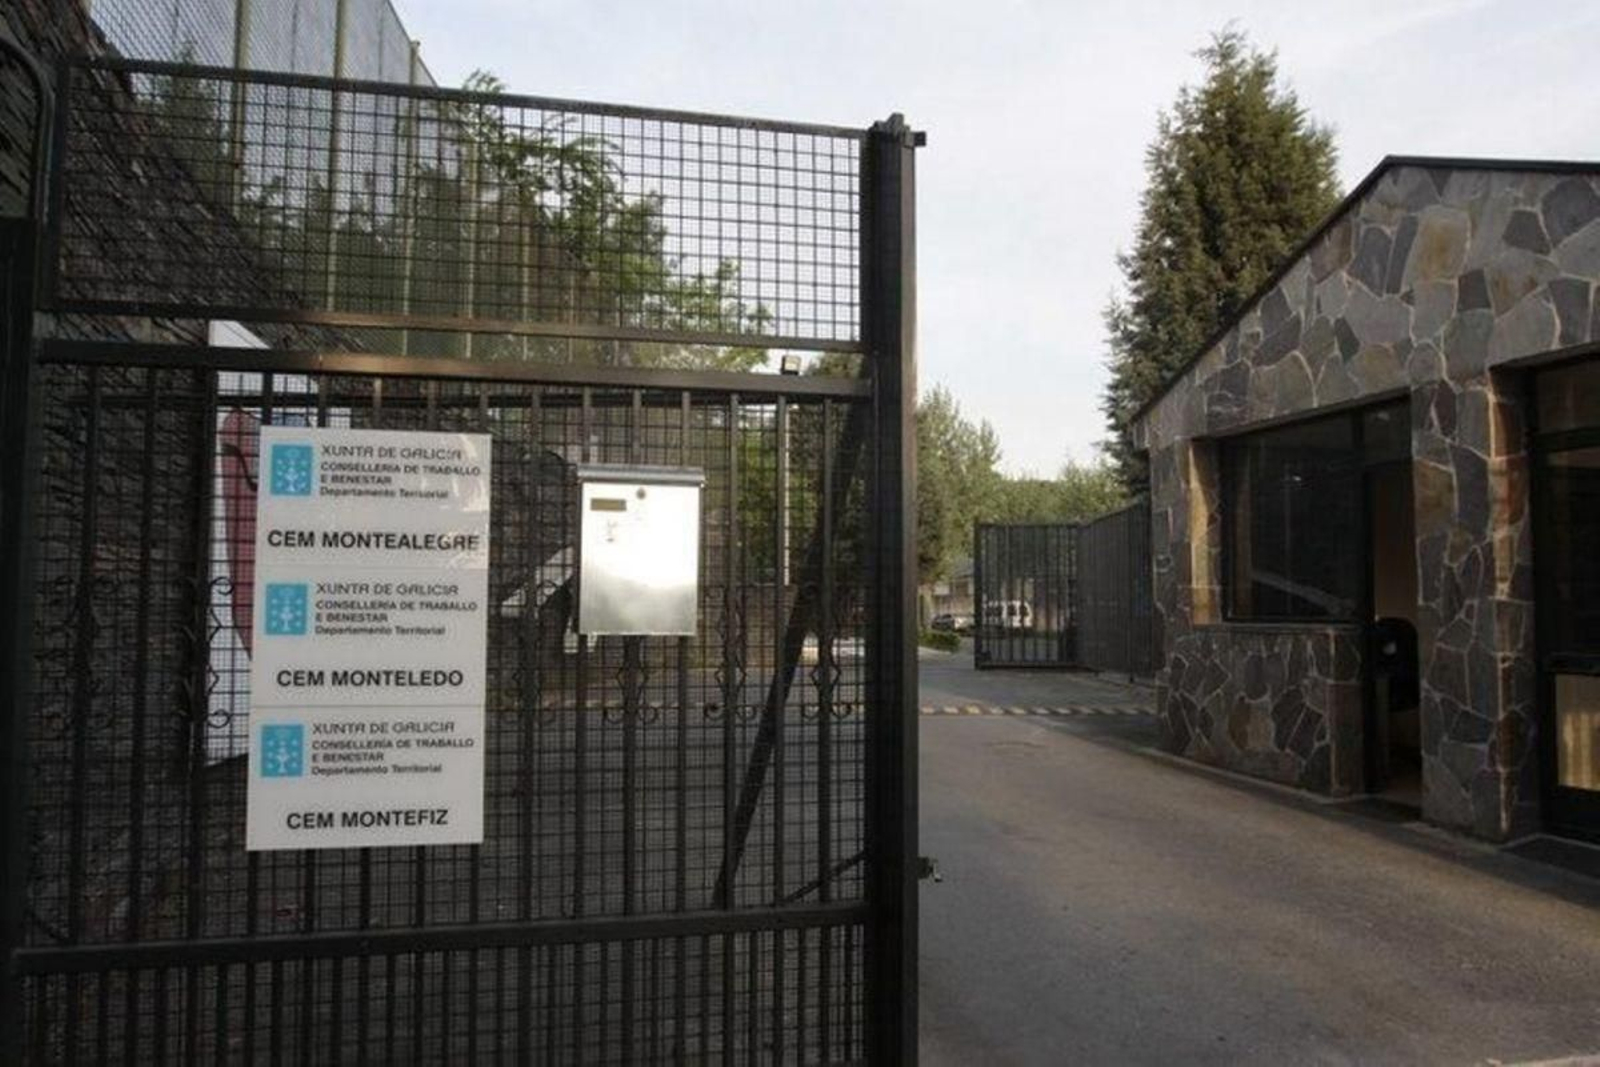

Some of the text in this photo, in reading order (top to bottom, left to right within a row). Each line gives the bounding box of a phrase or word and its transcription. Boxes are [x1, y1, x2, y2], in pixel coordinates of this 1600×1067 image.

[321, 444, 462, 460] XUNTA DE GALICIA
[404, 464, 419, 475] DE
[422, 465, 481, 477] TRABALLO
[320, 474, 392, 485] E BENESTAR
[320, 486, 396, 498] Departamento
[267, 530, 480, 551] CEM MONTEALEGRE
[315, 583, 459, 596] XUNTA DE GALICIA
[400, 601, 416, 611] DE
[419, 601, 479, 612] TRABALLO
[315, 612, 389, 623] E BENESTAR
[314, 625, 393, 637] Departamento
[276, 669, 464, 687] CEM MONTELEDO
[312, 721, 455, 735] XUNTA DE GALICIA
[395, 739, 411, 749] DE
[415, 738, 475, 749] TRABALLO
[312, 751, 385, 763] E BENESTAR
[311, 764, 389, 778] Departamento
[286, 809, 449, 830] CEM MONTEFIZ
